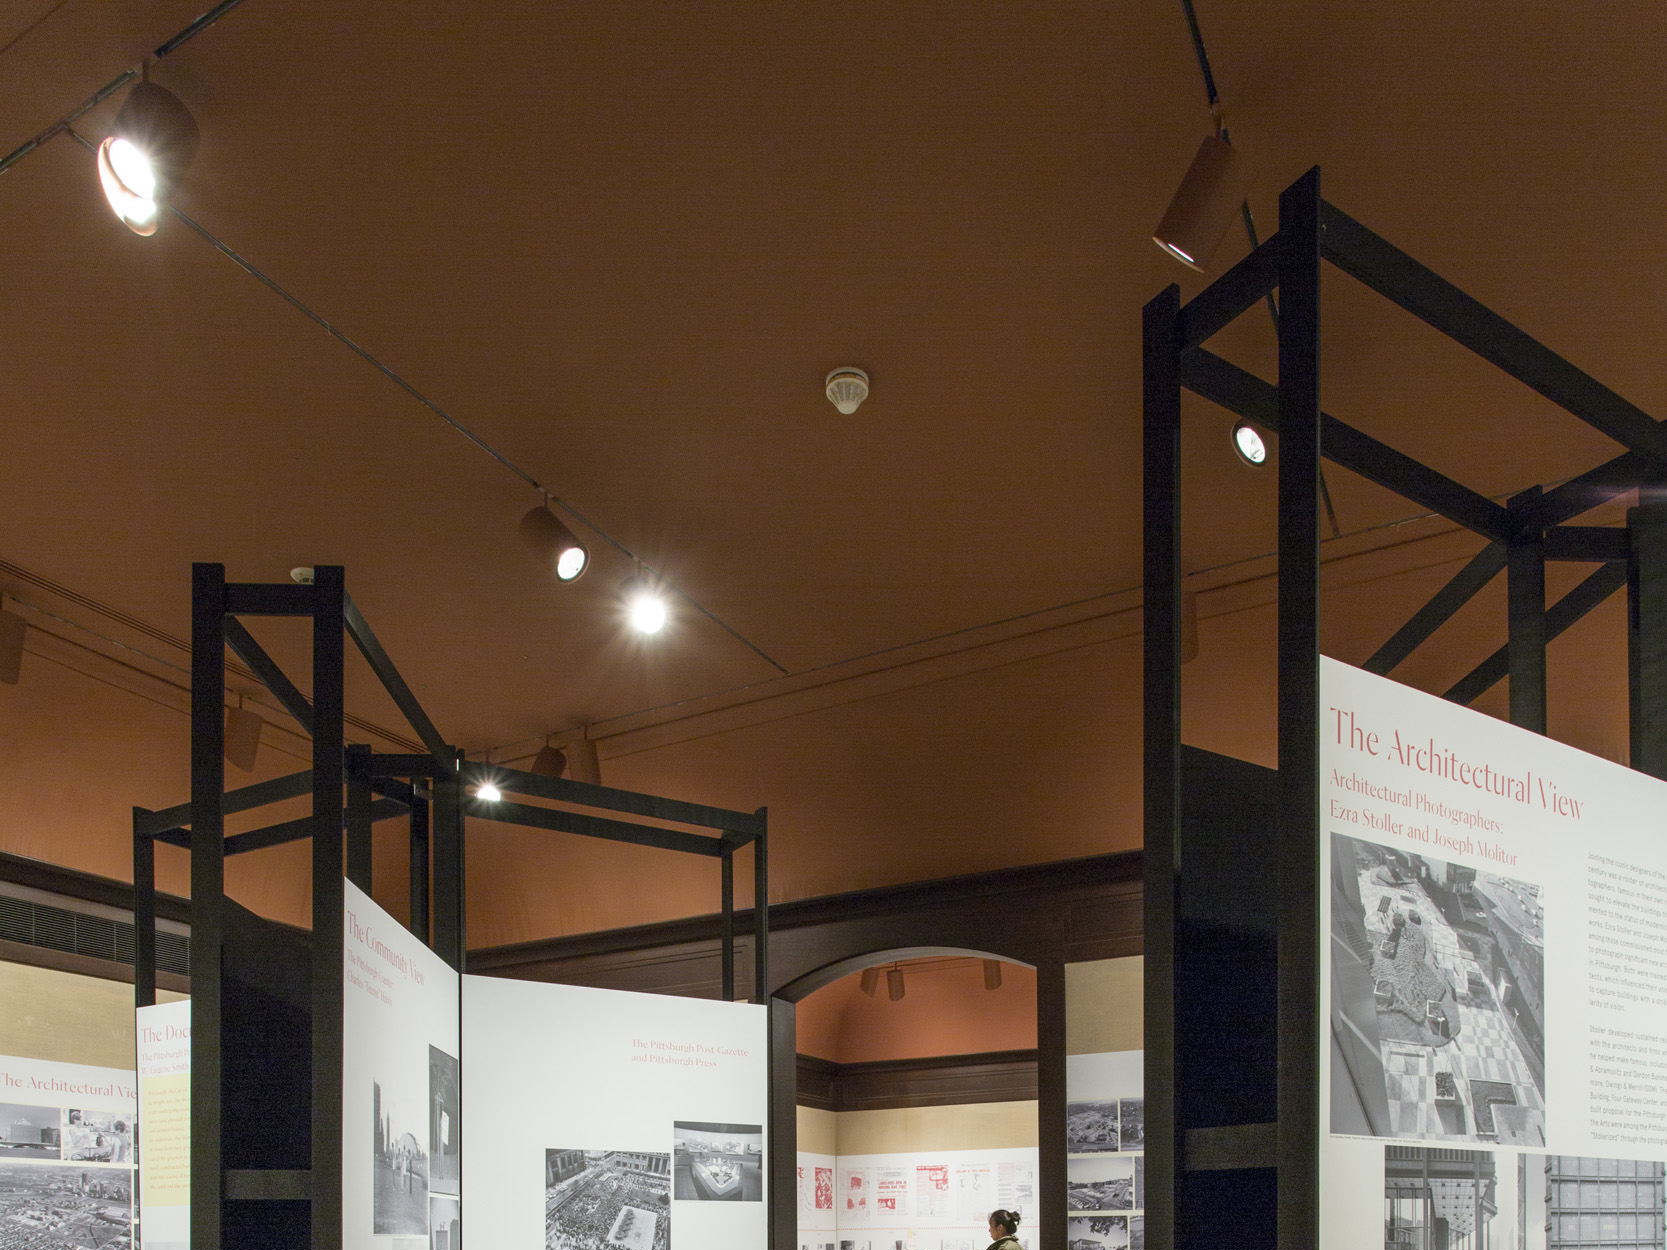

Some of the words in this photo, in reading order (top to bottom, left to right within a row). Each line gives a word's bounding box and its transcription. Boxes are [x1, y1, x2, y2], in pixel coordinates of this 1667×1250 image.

[1330, 708, 1379, 756] The
[1388, 729, 1530, 805] Architectural
[1539, 778, 1584, 820] View
[1330, 768, 1411, 807] Architectural
[1416, 793, 1503, 834] Photographers:
[1330, 799, 1358, 824] Ezra
[1363, 809, 1404, 835] Stoller
[1408, 825, 1429, 843] and
[1432, 829, 1474, 855] Joseph
[1478, 840, 1518, 866] Molitor
[348, 910, 364, 943] The
[366, 927, 408, 979] Community
[409, 960, 425, 986] View
[141, 1026, 162, 1044] The
[166, 1025, 191, 1041] Doc
[632, 1039, 648, 1049] The
[651, 1040, 694, 1054] Pittsburgh
[697, 1044, 749, 1057] Post-Gazette
[632, 1053, 647, 1062] and
[650, 1055, 693, 1067] Pittsburgh
[696, 1058, 718, 1067] Press
[27, 1076, 113, 1097] Architectural
